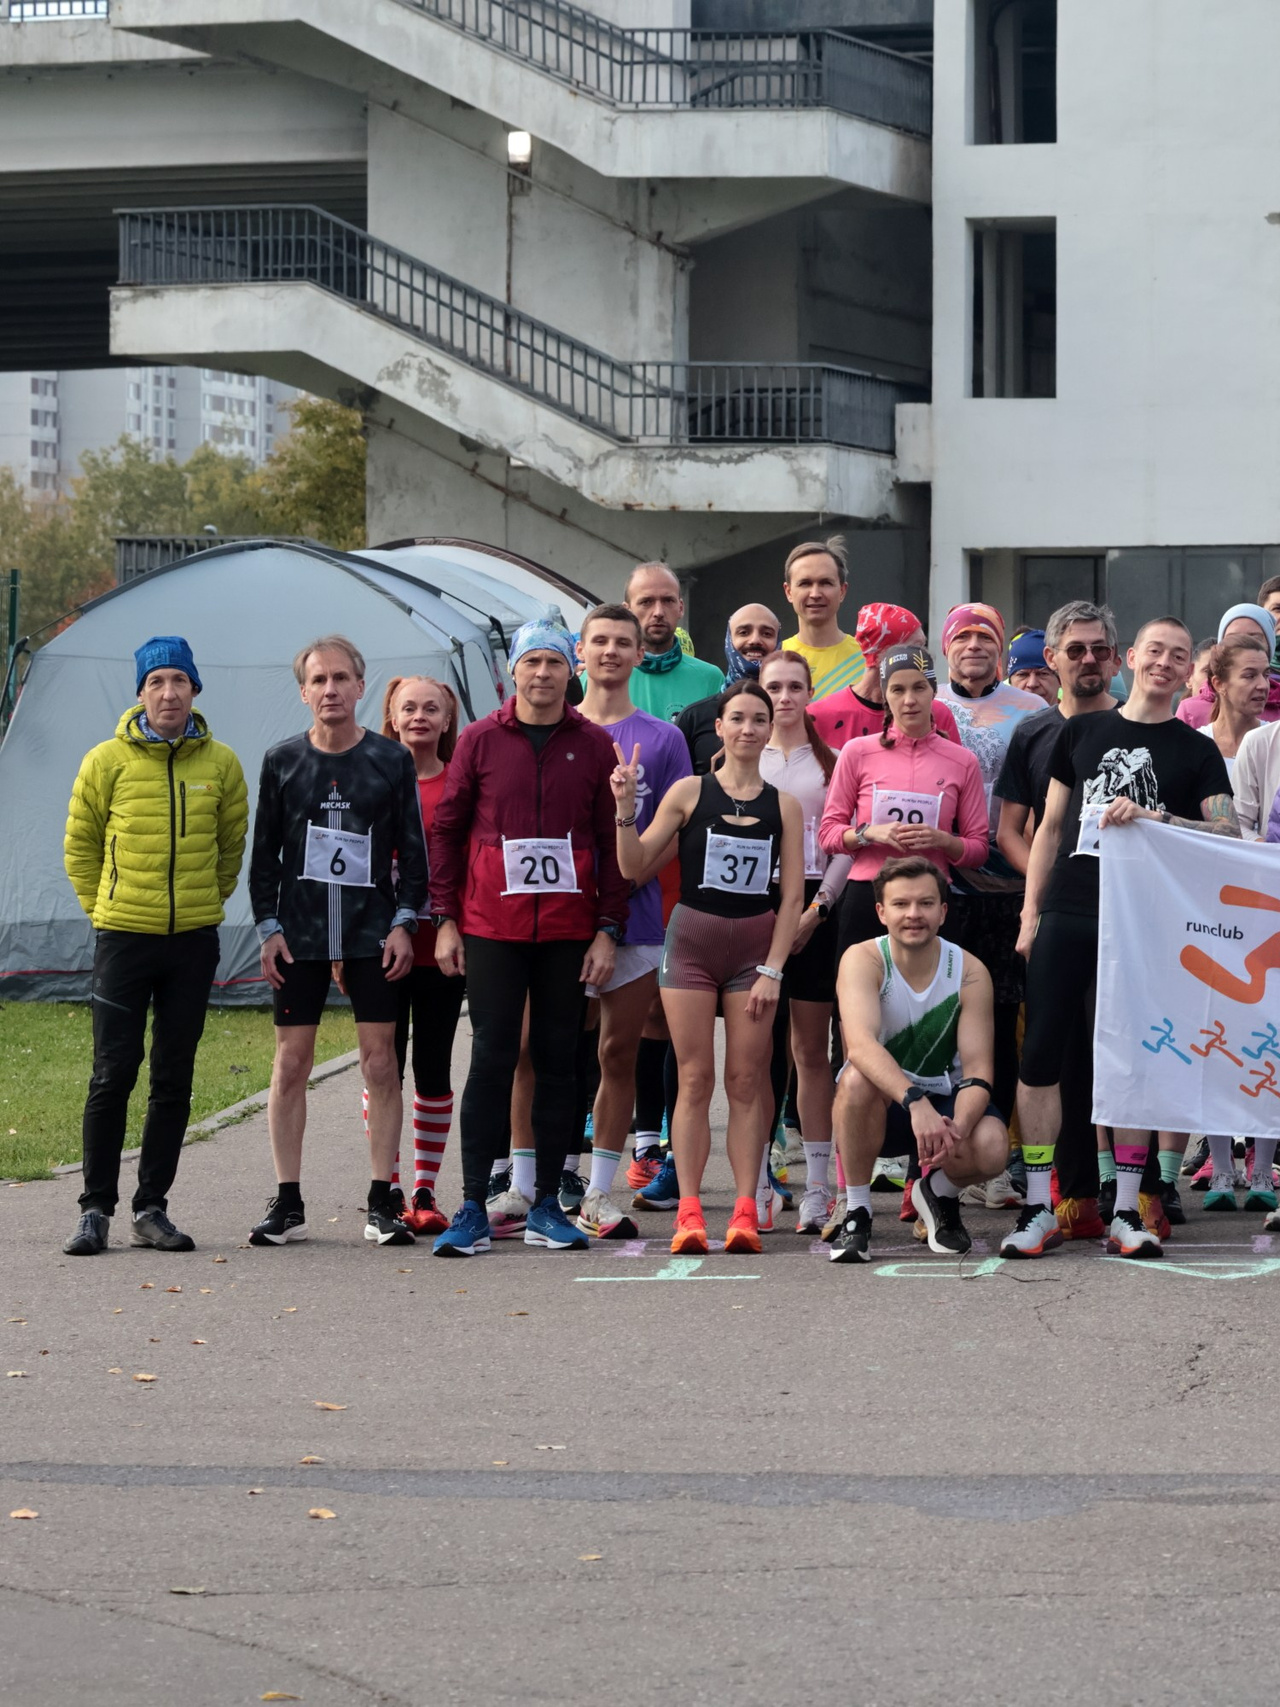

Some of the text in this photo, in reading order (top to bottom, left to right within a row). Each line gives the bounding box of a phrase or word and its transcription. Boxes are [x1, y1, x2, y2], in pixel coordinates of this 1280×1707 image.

[320, 801, 351, 809] MRCMSK
[330, 847, 346, 876] 6
[520, 855, 560, 885] 20
[720, 854, 758, 886] 37
[1186, 918, 1244, 941] runclub
[946, 949, 954, 979] INSANITY
